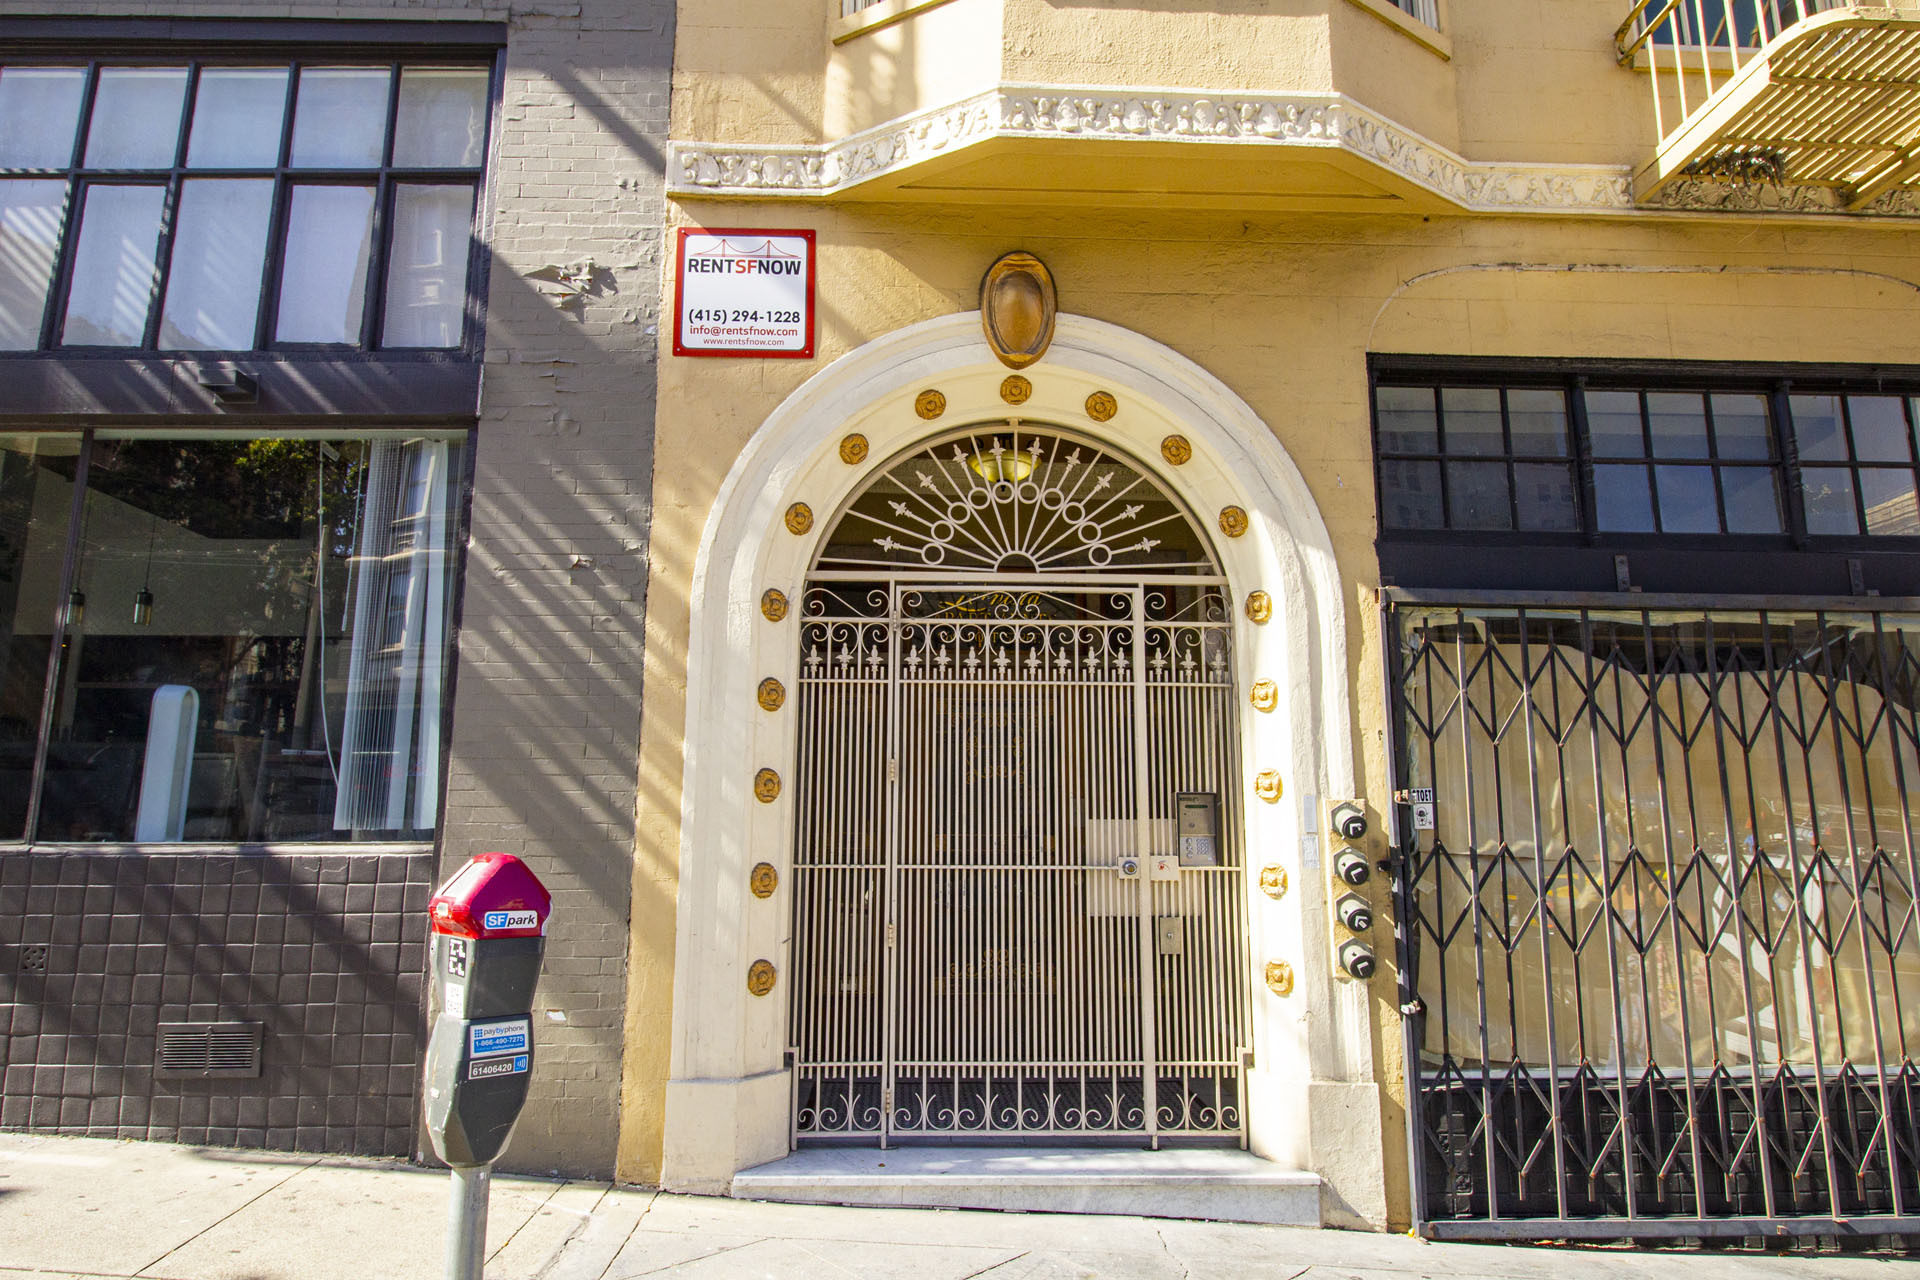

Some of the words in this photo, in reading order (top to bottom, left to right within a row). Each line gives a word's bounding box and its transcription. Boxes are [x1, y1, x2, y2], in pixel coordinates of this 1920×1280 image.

[688, 258, 801, 275] RENTSFNOW
[688, 309, 728, 324] (415)
[731, 310, 801, 323] 294-1228
[690, 325, 798, 336] info@rentsfnow.com
[703, 338, 784, 346] www.rentsfnow.com
[483, 1025, 525, 1037] paybyphone
[472, 1063, 512, 1076] 61406420
